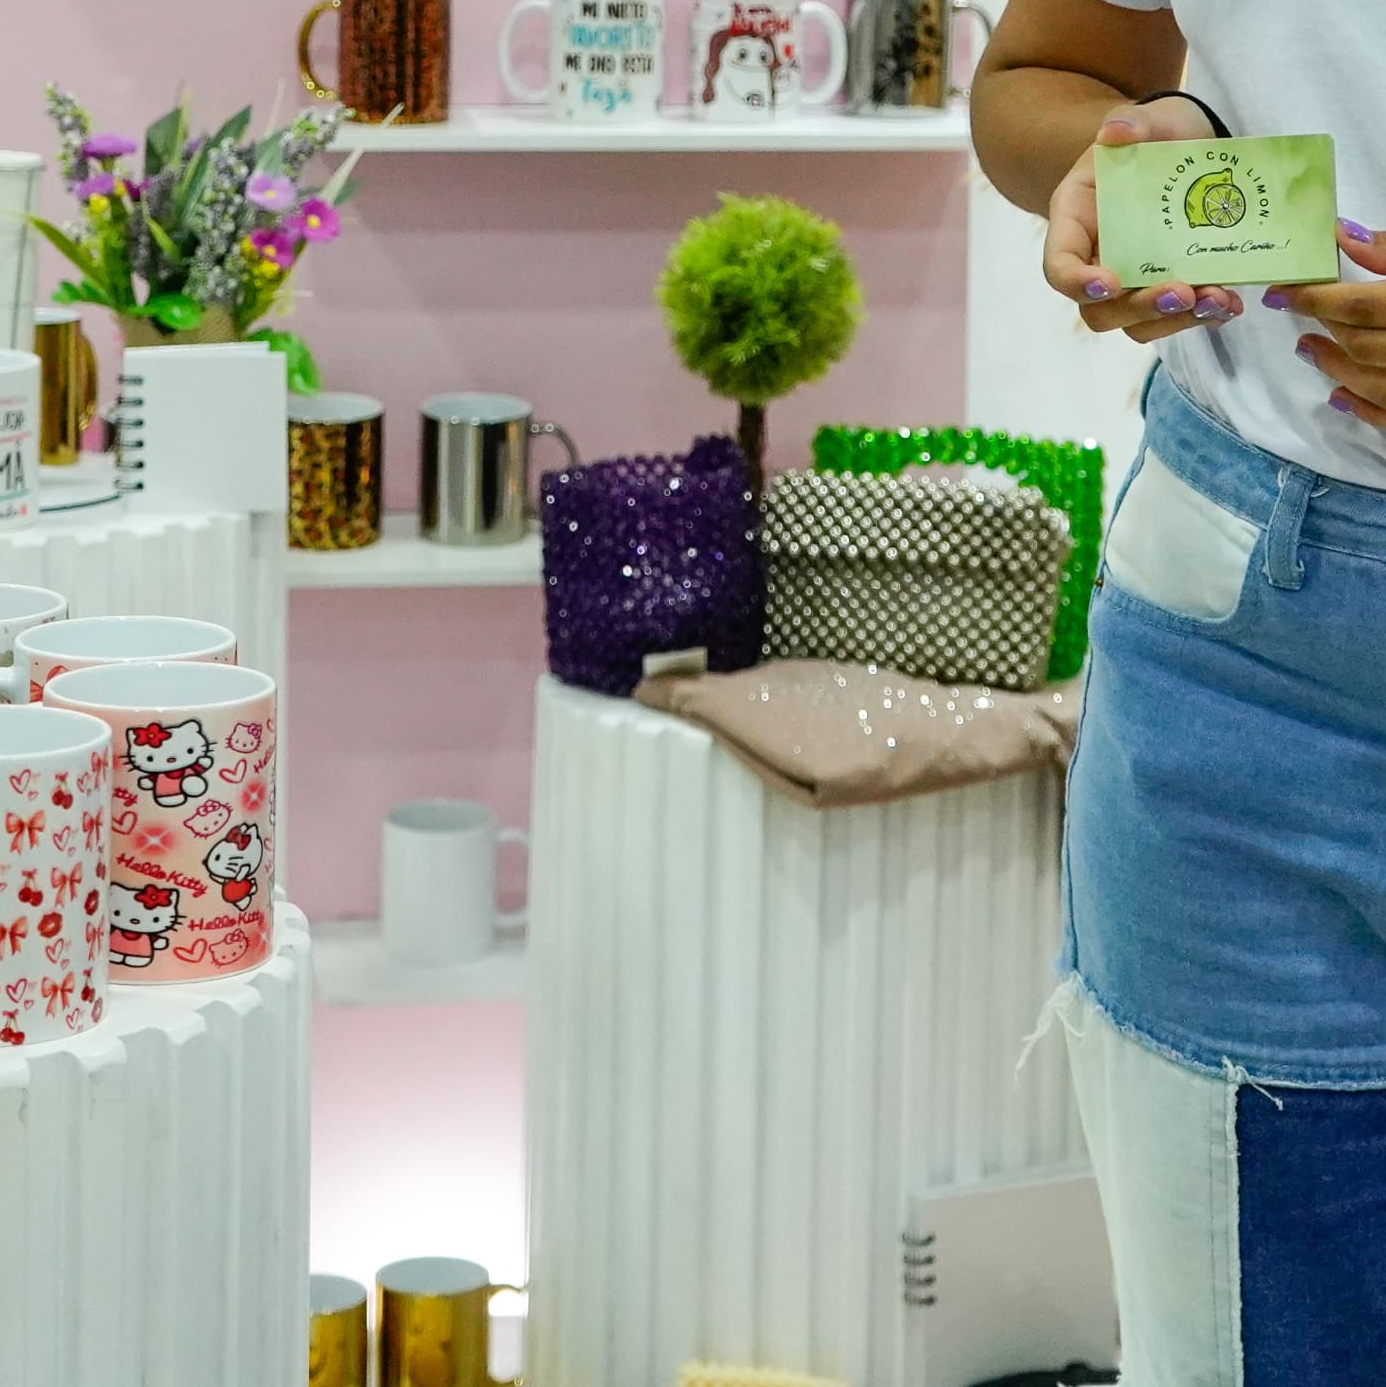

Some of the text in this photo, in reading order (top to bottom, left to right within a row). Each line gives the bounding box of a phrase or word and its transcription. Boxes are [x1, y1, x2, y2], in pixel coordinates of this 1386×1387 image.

[1161, 151, 1270, 226] PAPELON CON LIMON
[1186, 242, 1208, 256] Con
[116, 853, 209, 899] Hello Kitty
[188, 915, 237, 931] Hello
